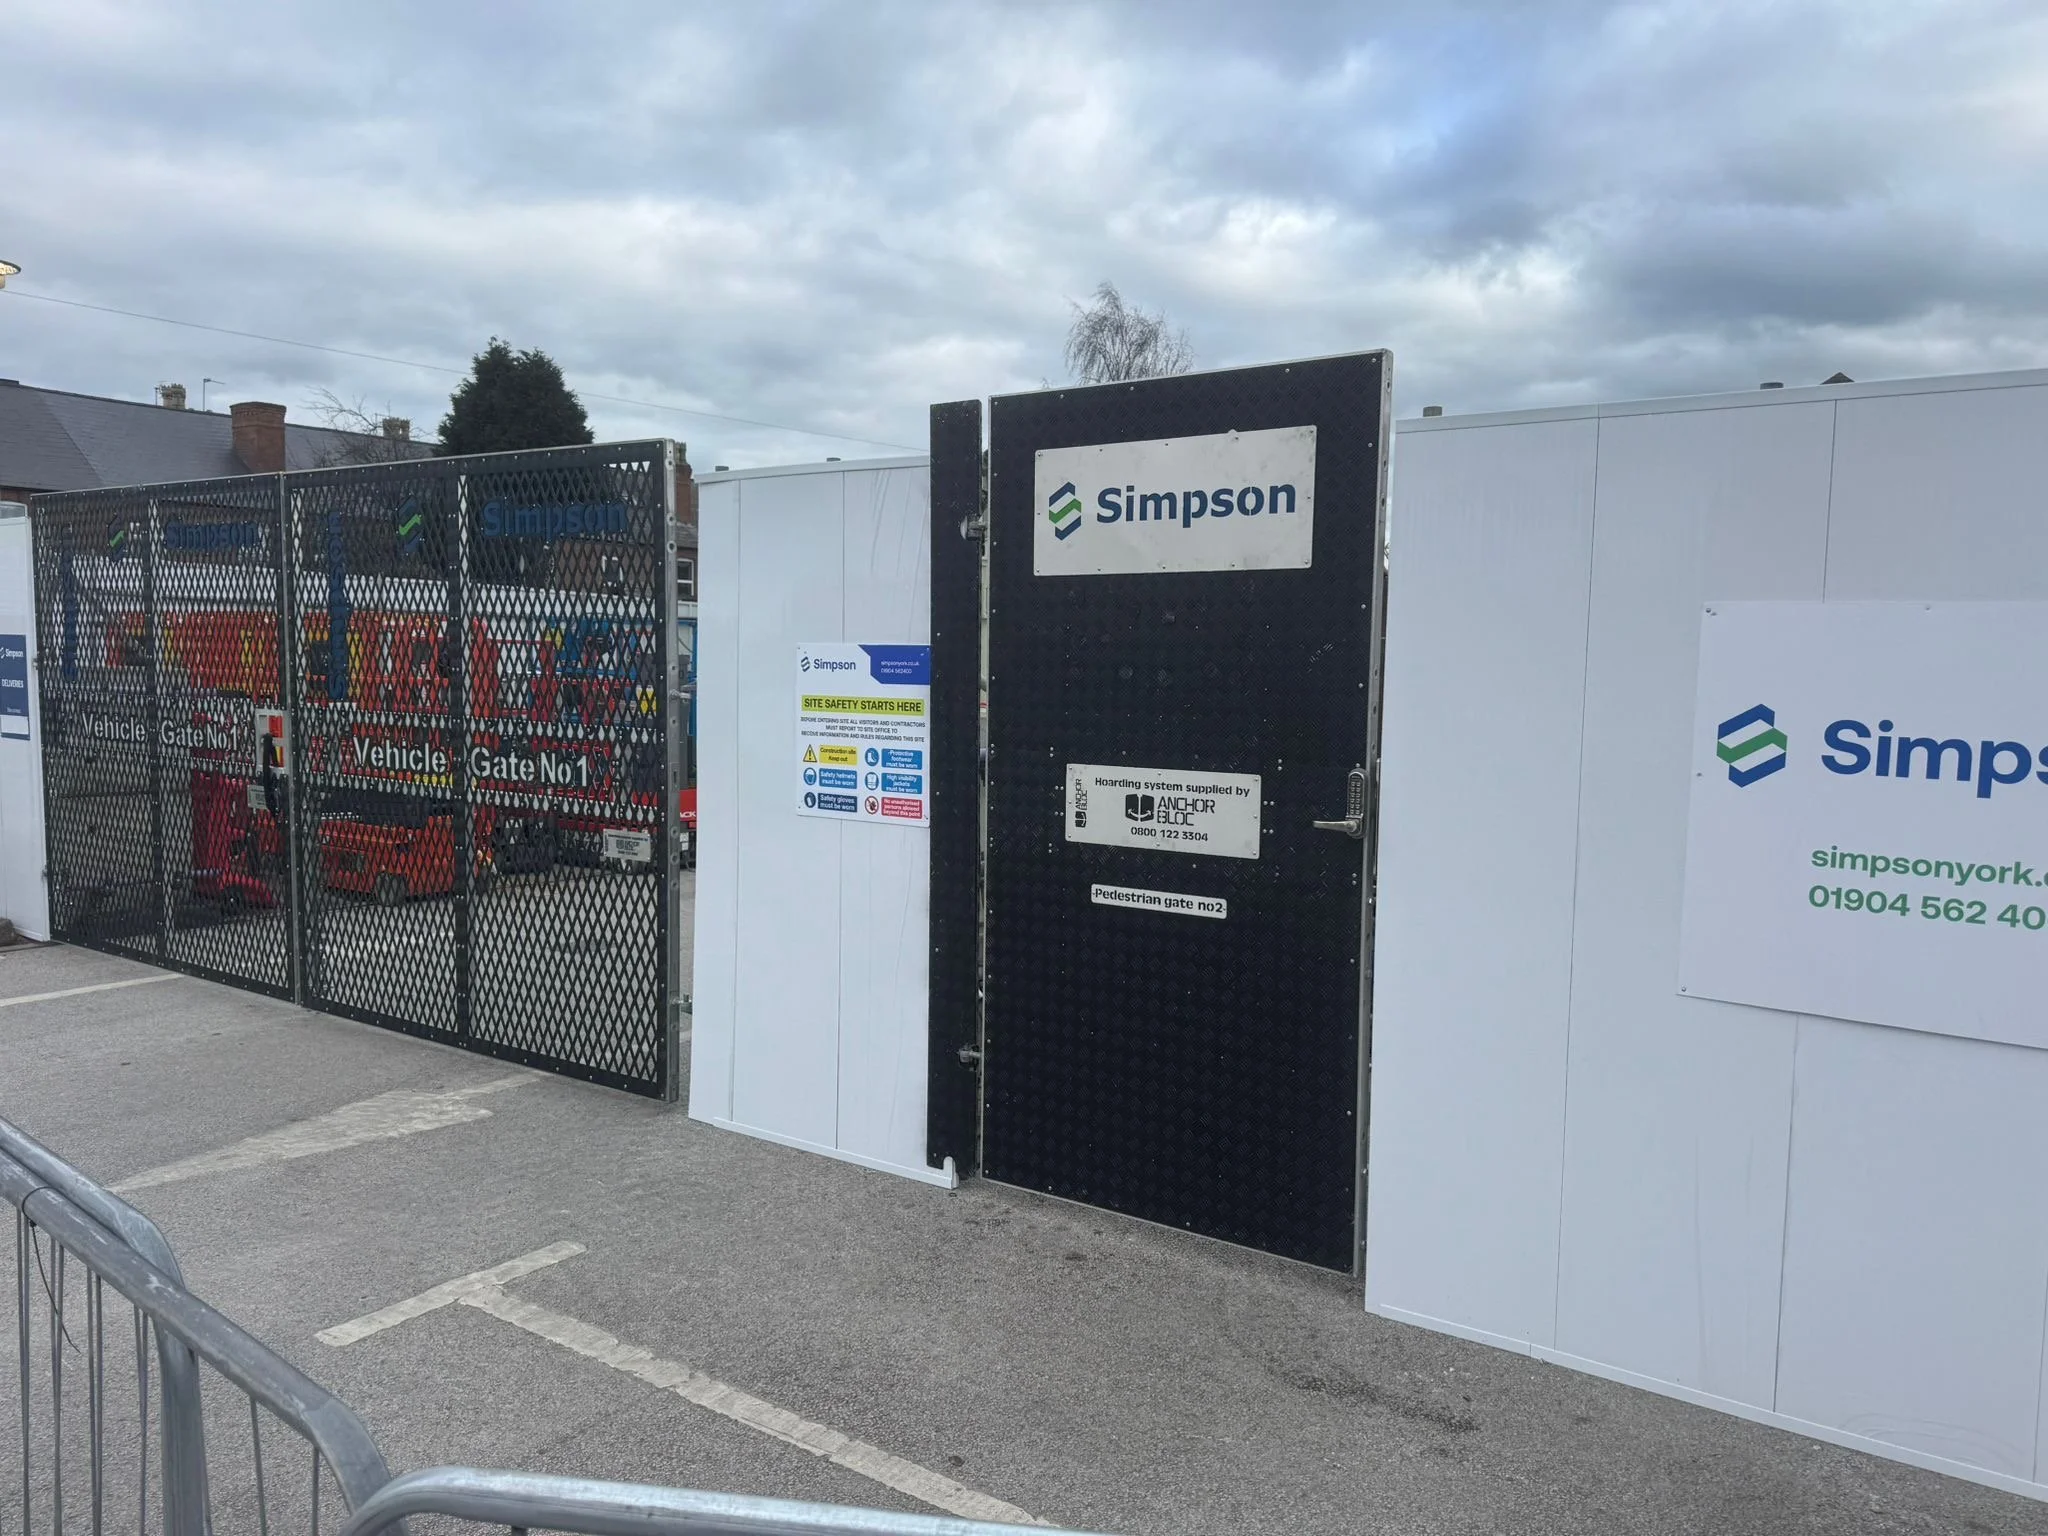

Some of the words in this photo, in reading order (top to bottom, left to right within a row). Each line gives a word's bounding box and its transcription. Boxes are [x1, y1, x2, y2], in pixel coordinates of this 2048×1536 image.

[1096, 484, 1296, 528] Simpson
[483, 500, 628, 543] Simpson
[813, 658, 856, 672] Simpson
[2, 679, 24, 688] DELIVERIES
[804, 698, 823, 708] SITE
[825, 699, 858, 710] SAFETY
[861, 700, 895, 711] STARTS
[896, 701, 922, 712] HERE
[82, 712, 146, 742] Vehicle
[161, 719, 204, 749] Gate
[352, 735, 447, 774] Vehicle
[470, 746, 536, 782] Gate
[1821, 719, 2048, 799] Simp
[1095, 777, 1142, 790] Hoarding
[1144, 781, 1183, 792] system
[1186, 784, 1233, 796] supplied
[1235, 786, 1250, 797] by
[1157, 796, 1216, 814] ANCHOR
[1156, 810, 1195, 826] BLOC
[1130, 826, 1156, 837] 0800
[1160, 829, 1179, 840] 122
[1182, 831, 1208, 842] 3304
[1811, 845, 2048, 888] simpsonyork.
[1095, 888, 1162, 906] Pedestrian
[1164, 896, 1194, 908] gate
[1198, 901, 1224, 913] no2
[1808, 885, 1911, 917] 01904
[1920, 896, 1987, 925] 562
[1996, 904, 2048, 930] 40
